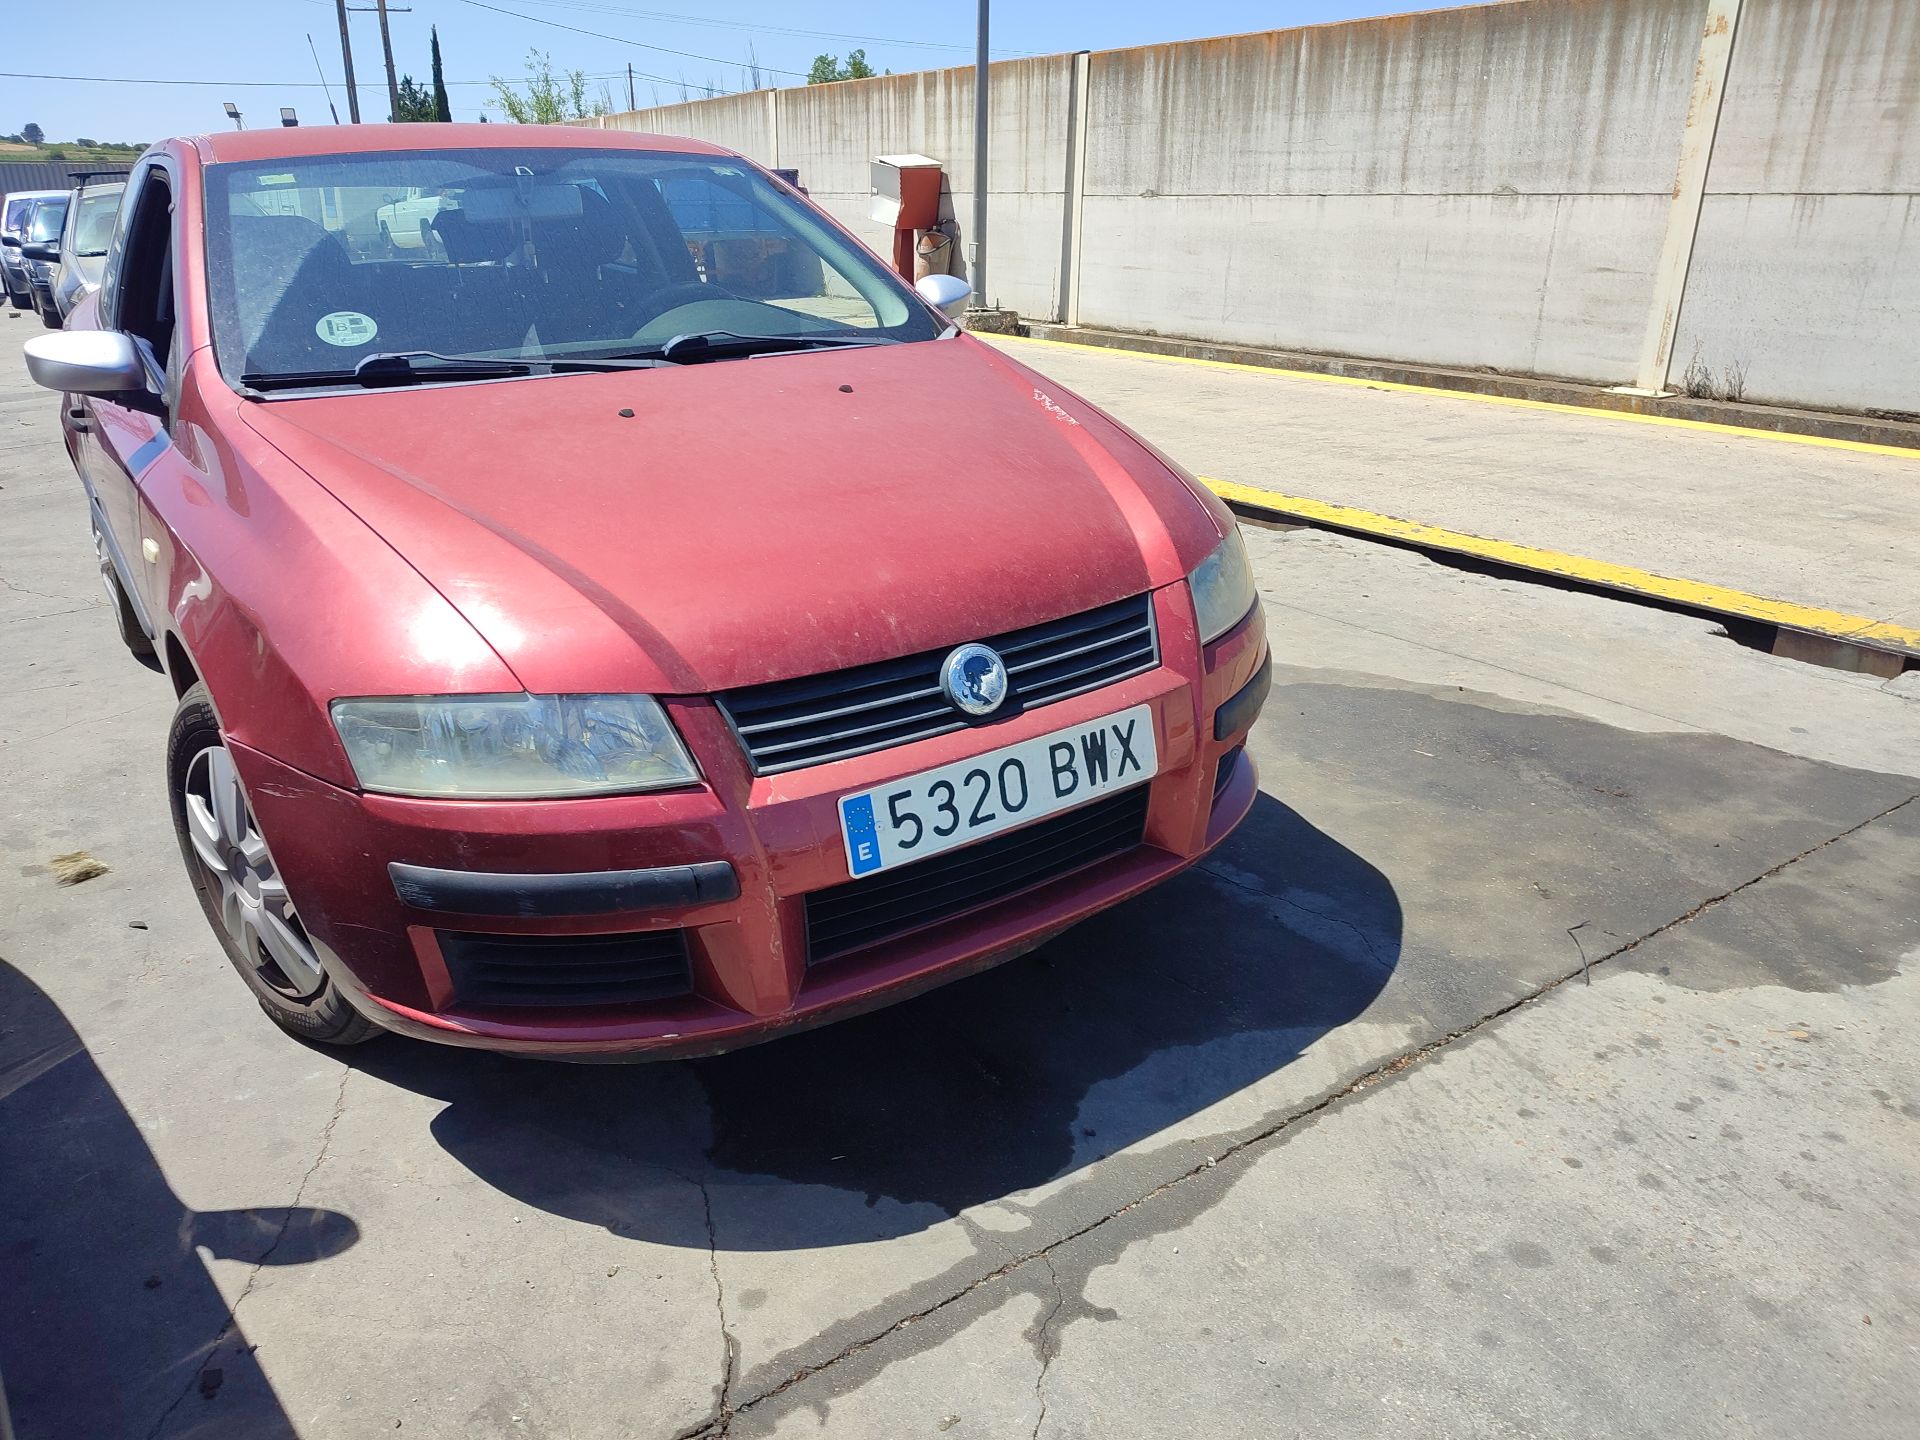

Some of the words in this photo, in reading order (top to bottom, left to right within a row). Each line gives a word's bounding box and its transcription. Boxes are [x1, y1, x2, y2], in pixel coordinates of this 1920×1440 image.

[888, 757, 1028, 849] 5320
[1048, 719, 1141, 798] BWX
[857, 842, 873, 861] E
